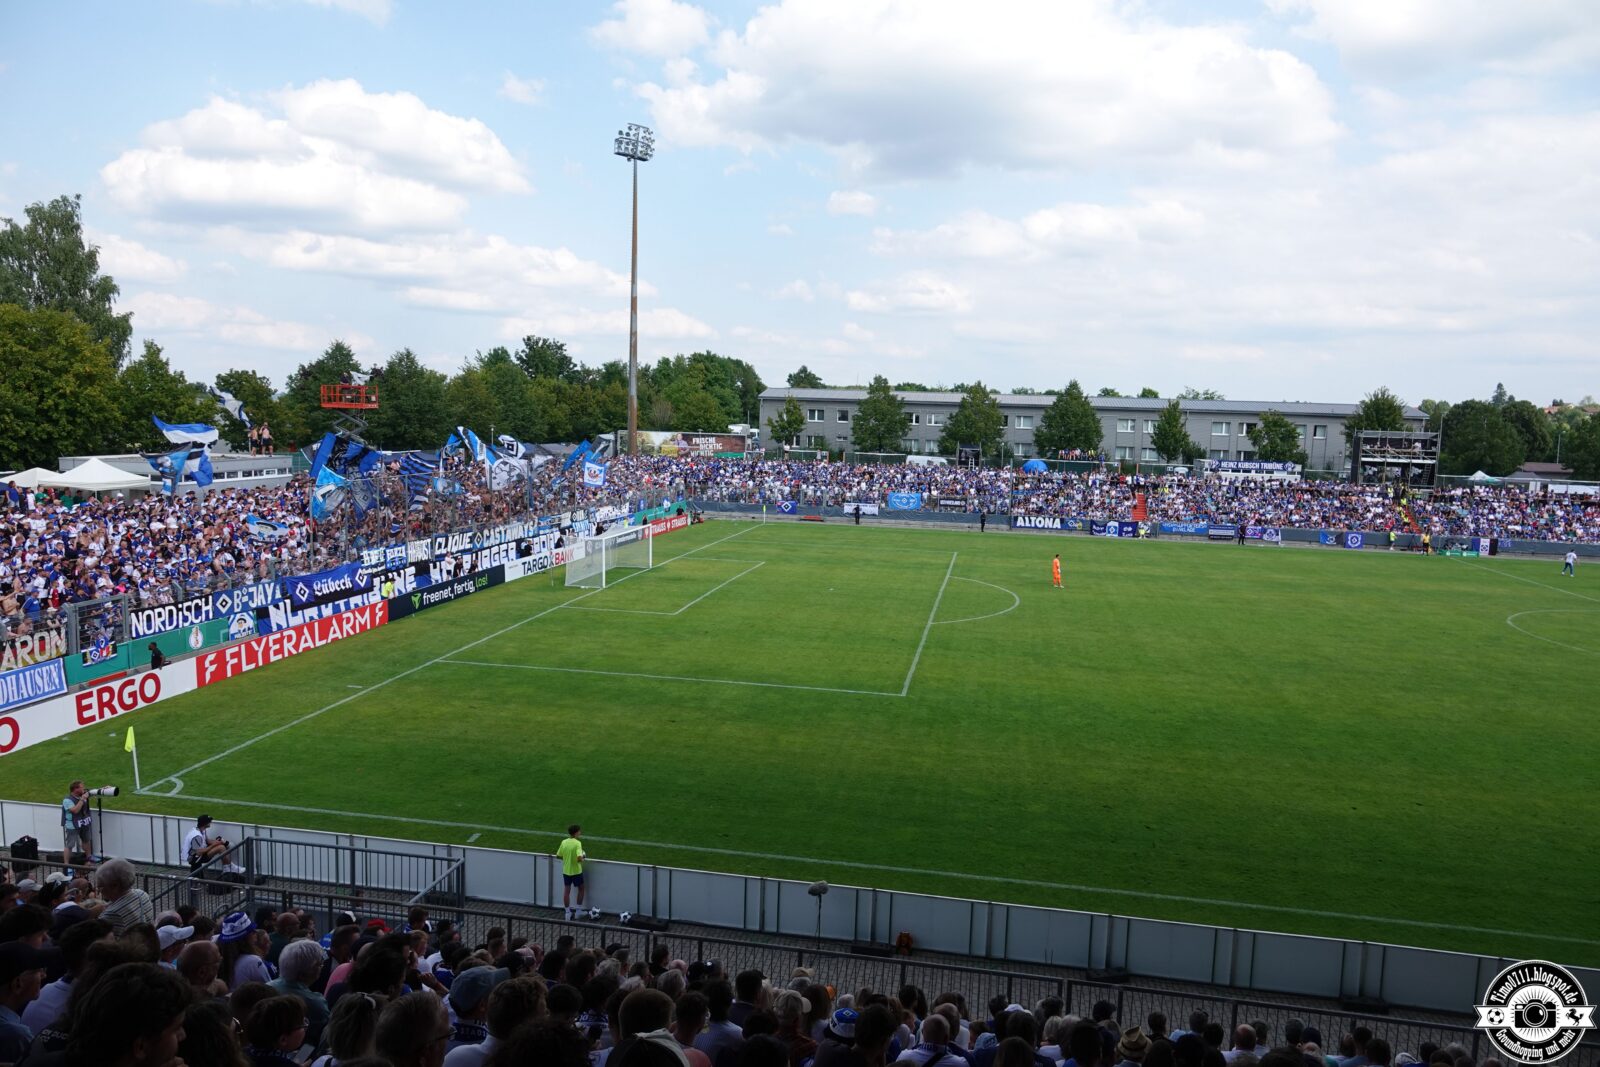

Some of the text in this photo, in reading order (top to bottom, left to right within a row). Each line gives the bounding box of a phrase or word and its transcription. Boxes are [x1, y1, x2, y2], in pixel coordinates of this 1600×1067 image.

[1260, 461, 1284, 470] TRIBÜNE
[1016, 516, 1061, 529] ALTONA
[313, 573, 353, 597] Lübeck
[225, 606, 371, 678] FLYERALARM
[75, 672, 161, 726] ERGO
